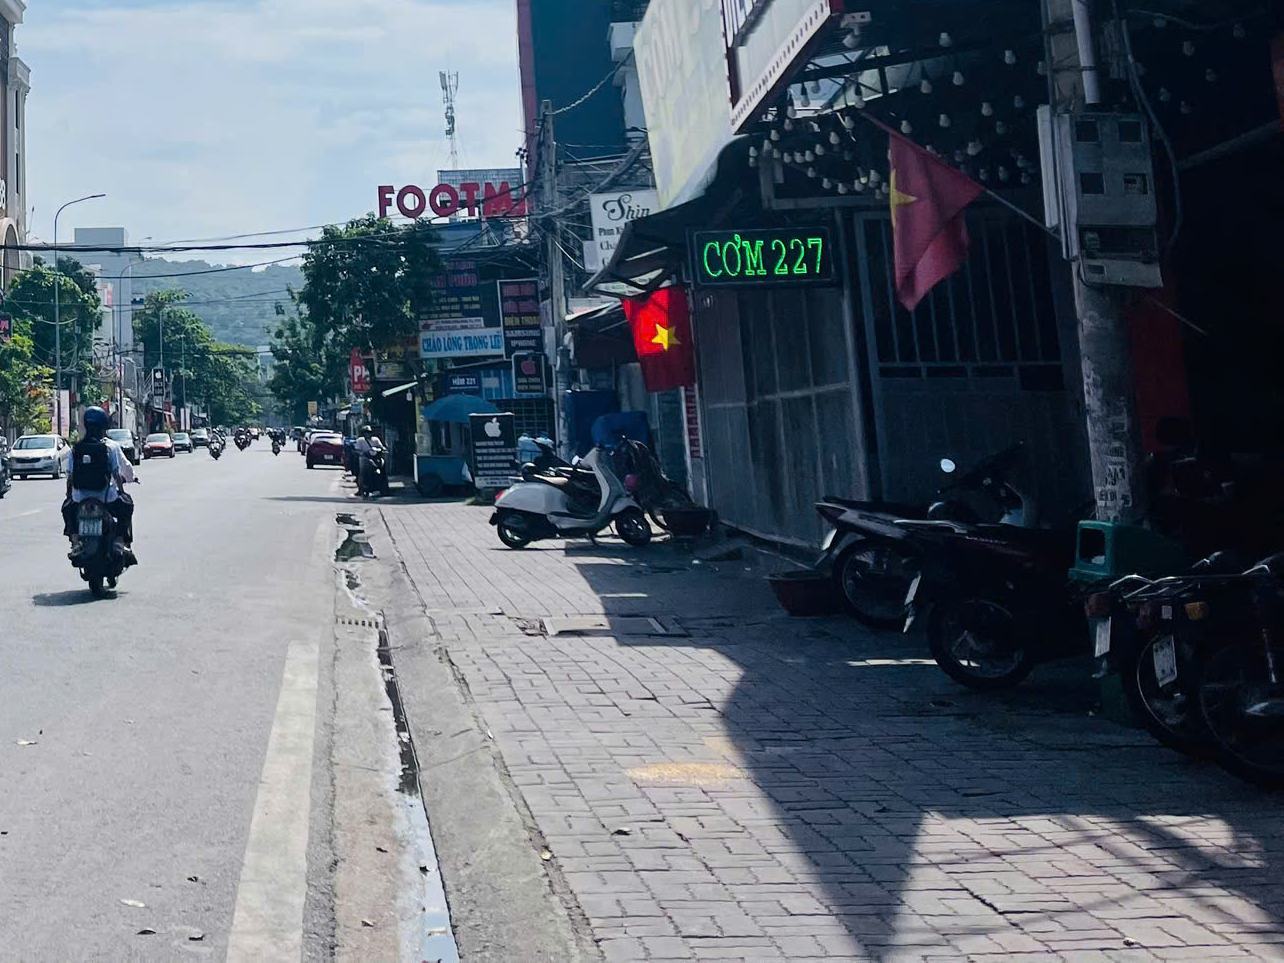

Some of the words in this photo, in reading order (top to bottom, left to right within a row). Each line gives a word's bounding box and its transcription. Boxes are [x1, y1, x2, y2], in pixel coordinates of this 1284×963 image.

[602, 194, 651, 221] Shin
[702, 234, 767, 276] CƠM
[771, 237, 822, 275] 227
